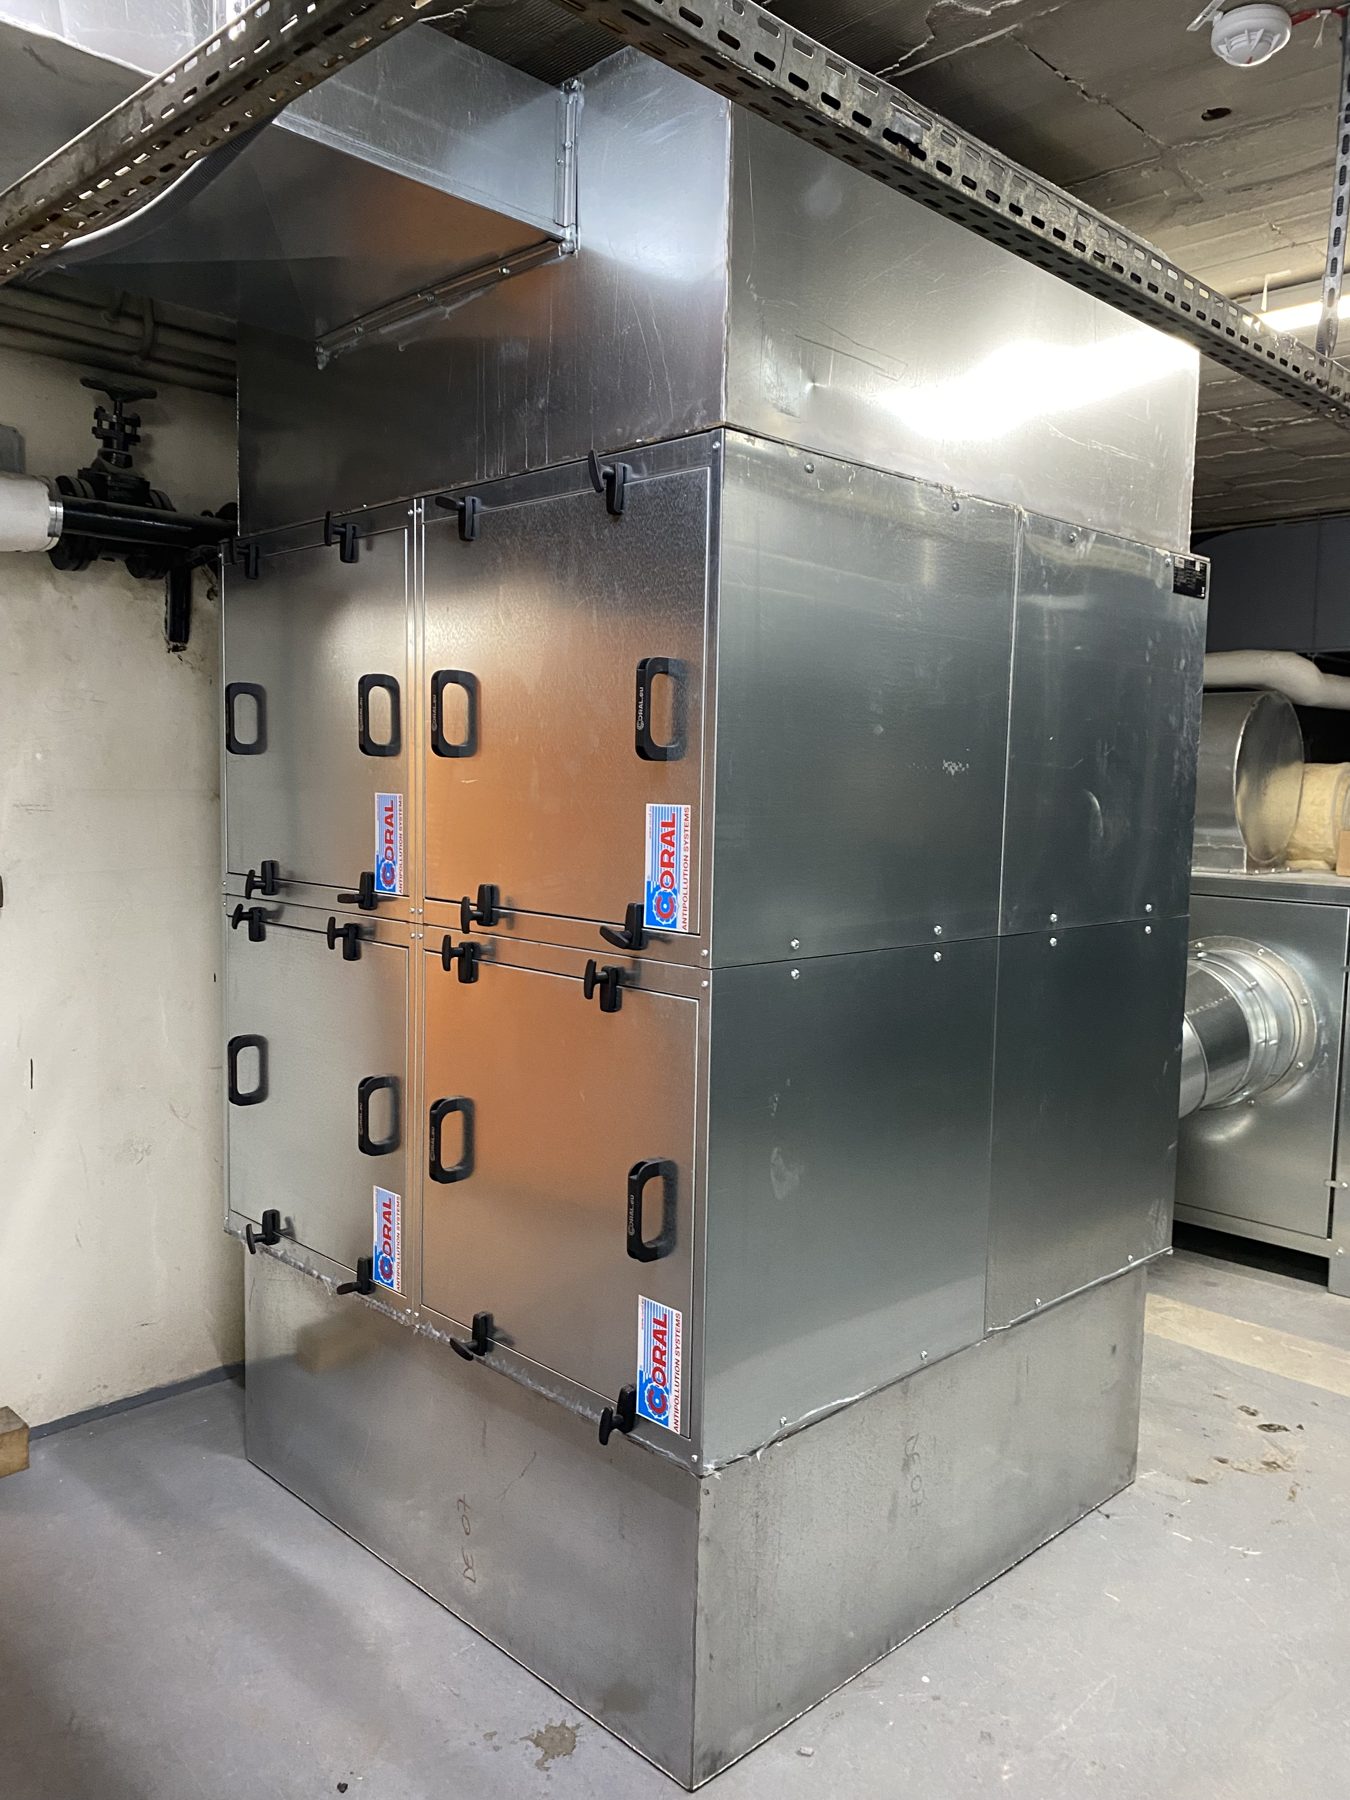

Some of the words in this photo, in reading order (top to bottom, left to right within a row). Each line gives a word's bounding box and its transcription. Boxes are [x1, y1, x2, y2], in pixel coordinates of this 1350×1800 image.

[381, 800, 395, 887] CORAL
[655, 812, 677, 920] CORAL
[682, 807, 690, 852] SYSTEMS
[681, 854, 690, 932] ANTIPOLLUTION
[379, 1197, 393, 1280] CORAL
[647, 1312, 668, 1415] CORAL
[672, 1359, 681, 1433] ANTIPOLLUTION
